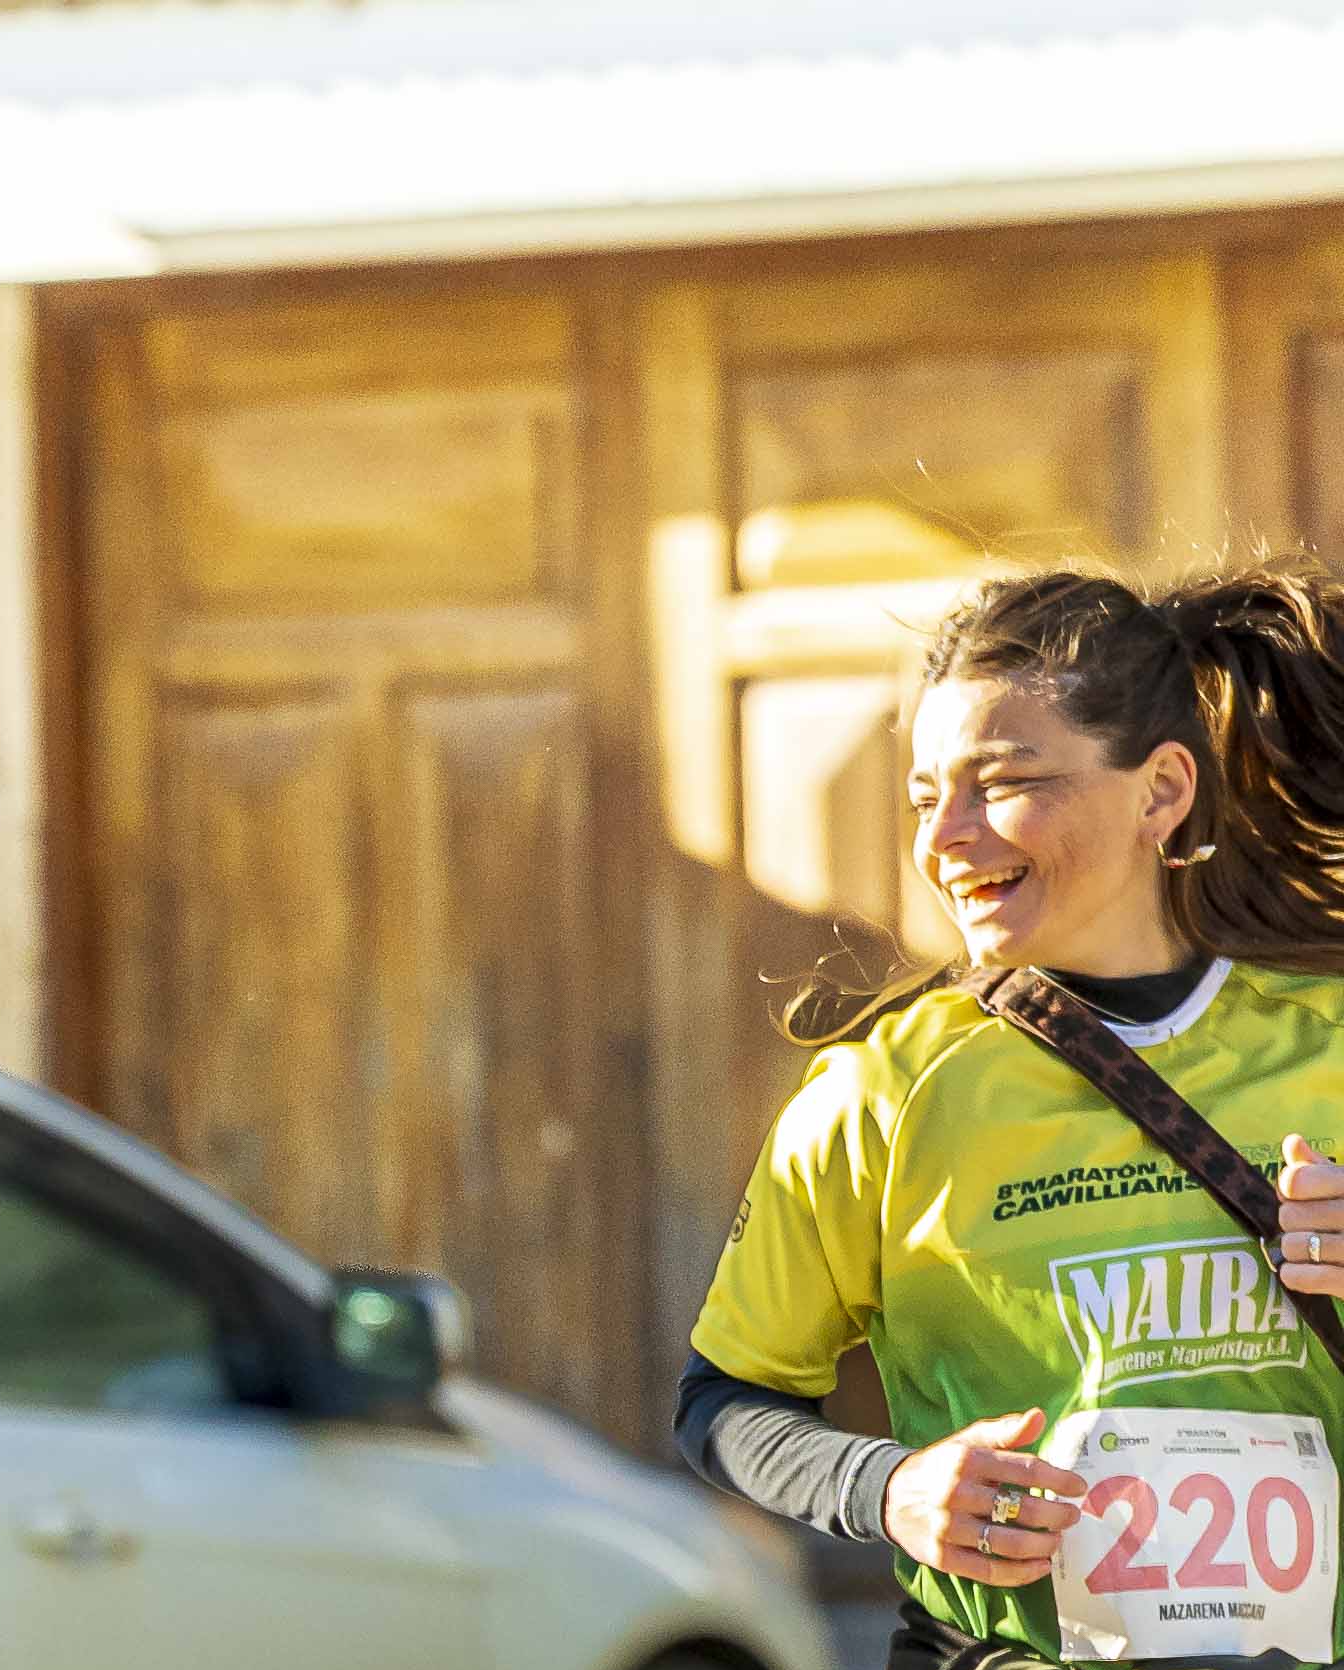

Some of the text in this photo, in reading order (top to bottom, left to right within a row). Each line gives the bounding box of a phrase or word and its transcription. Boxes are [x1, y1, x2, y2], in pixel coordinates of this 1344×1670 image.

[1069, 1251, 1298, 1350] MAIRA
[1081, 1472, 1314, 1595] 220
[1159, 1602, 1225, 1621] NAZARENA
